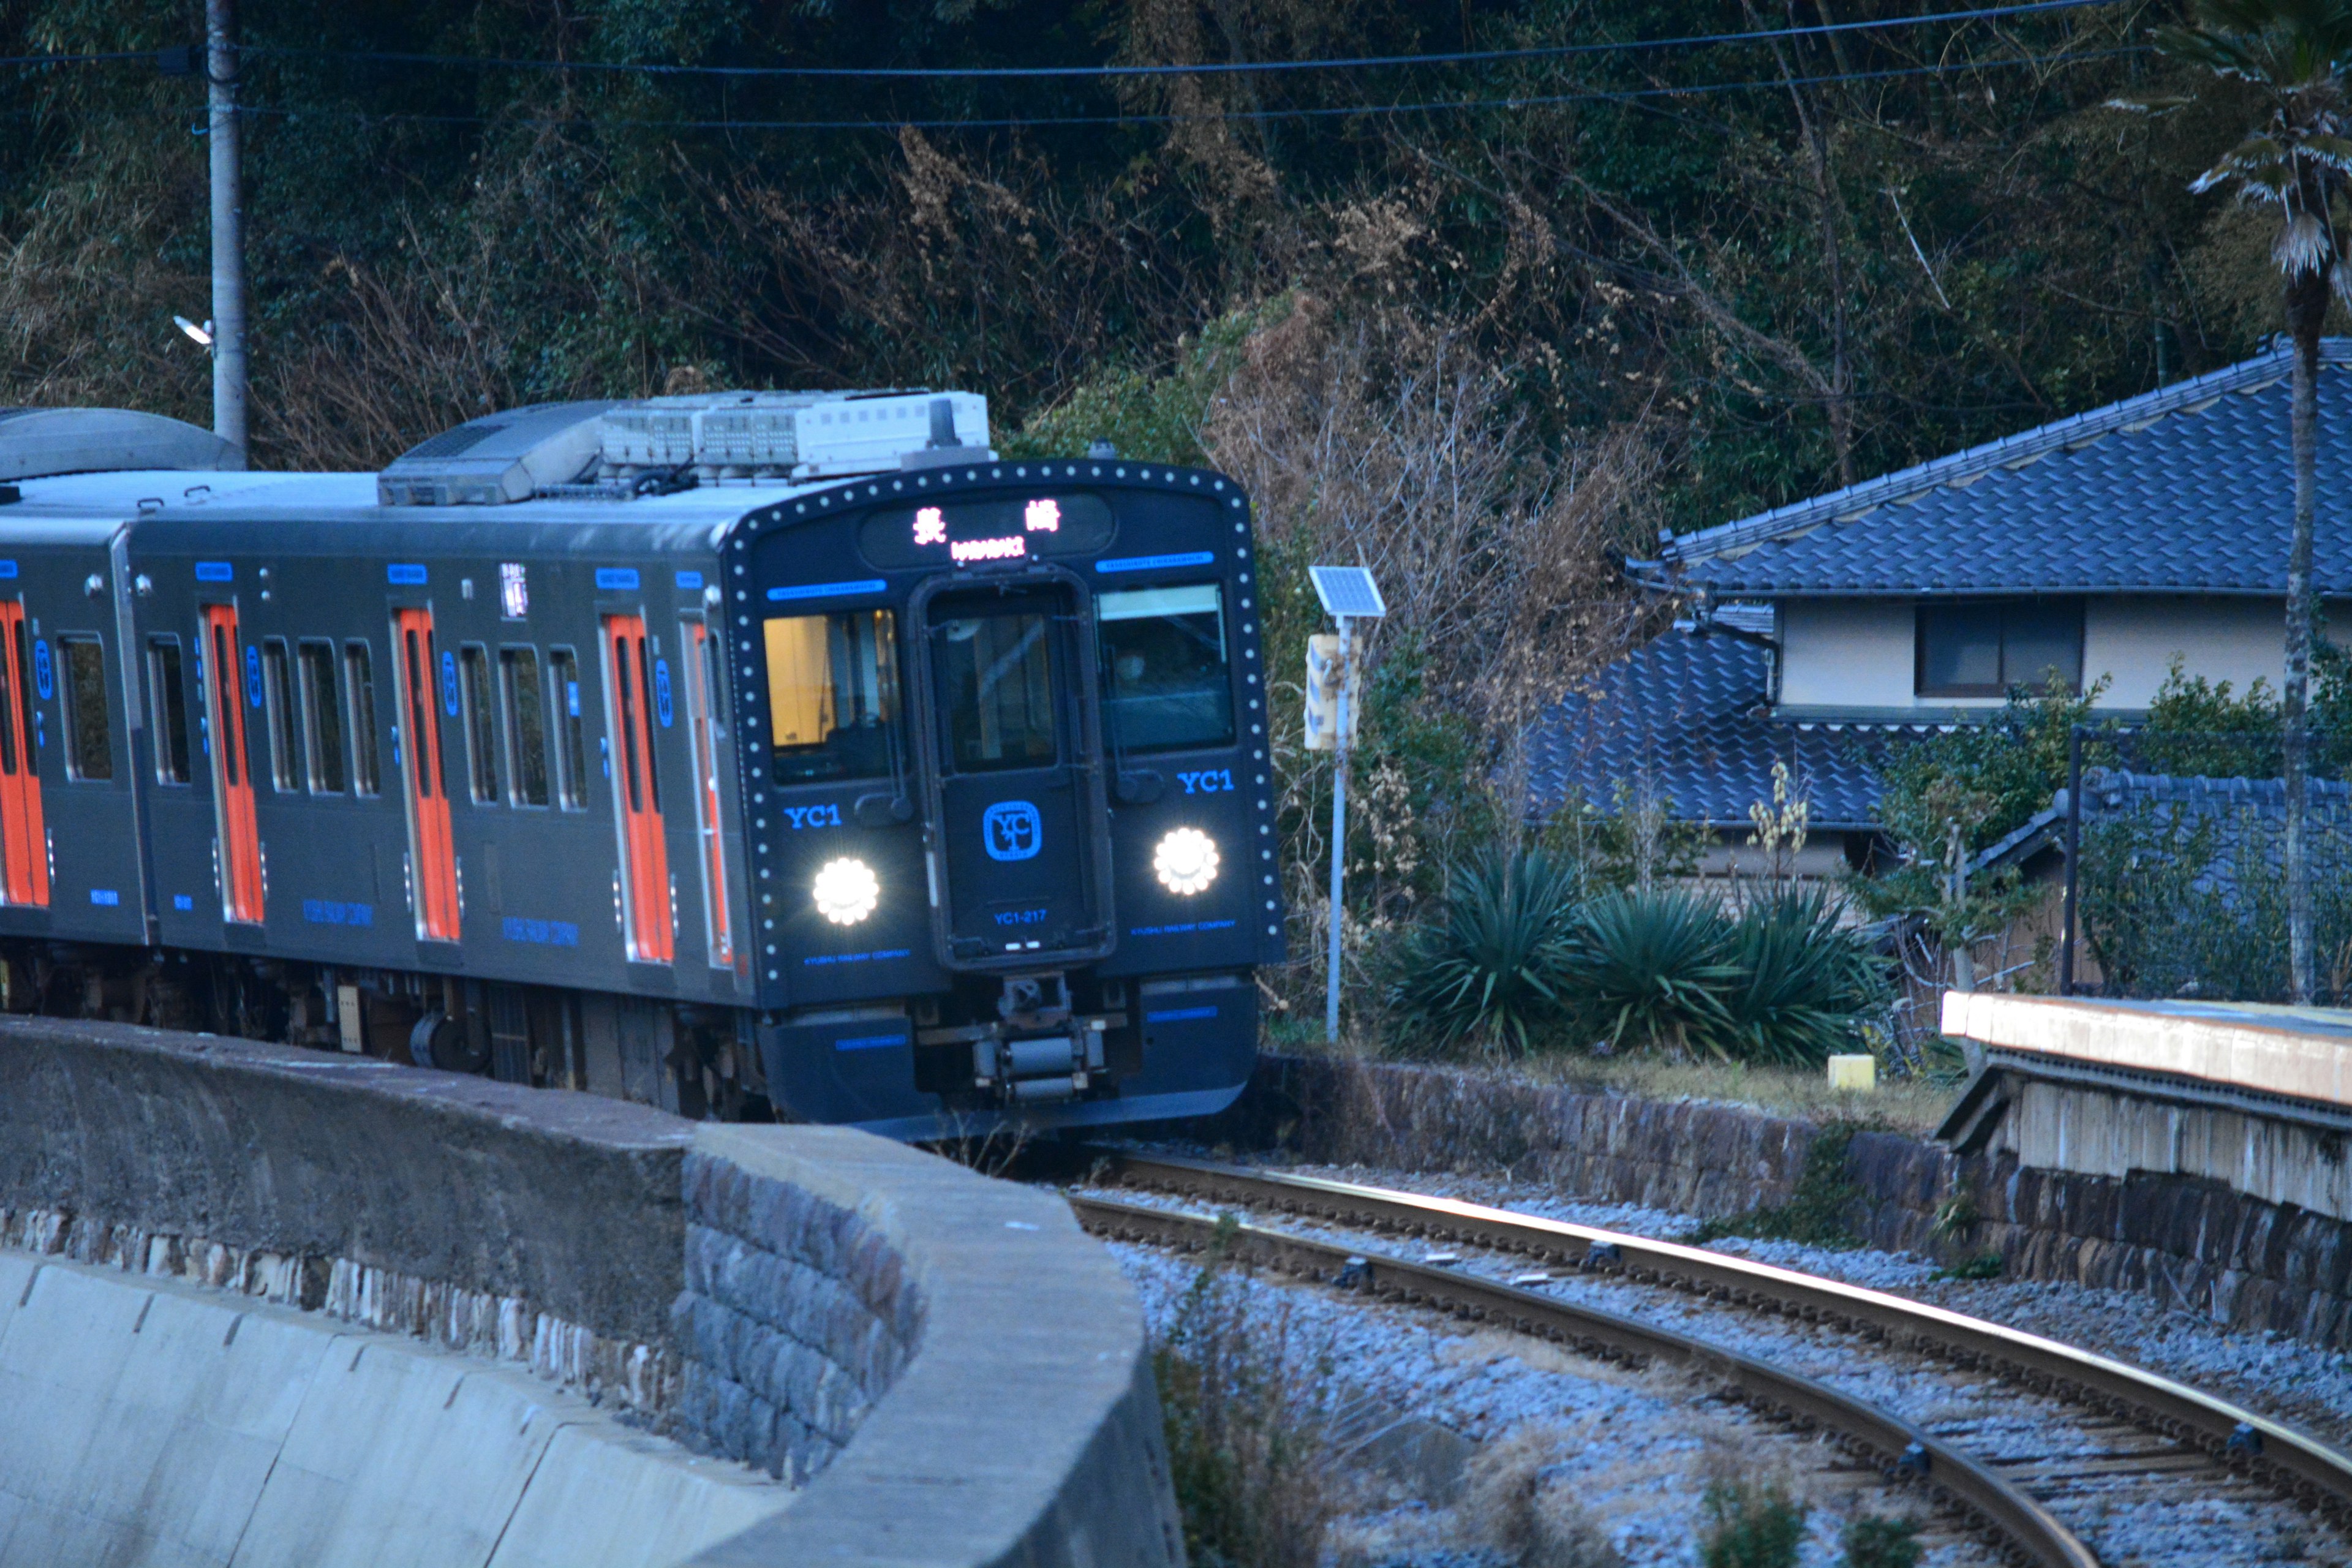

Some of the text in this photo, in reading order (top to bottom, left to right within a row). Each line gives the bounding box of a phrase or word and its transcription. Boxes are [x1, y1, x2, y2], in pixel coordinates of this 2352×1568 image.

[1177, 769, 1234, 793] YC1
[784, 804, 842, 829] YC1
[1198, 919, 1235, 931] COMPANY
